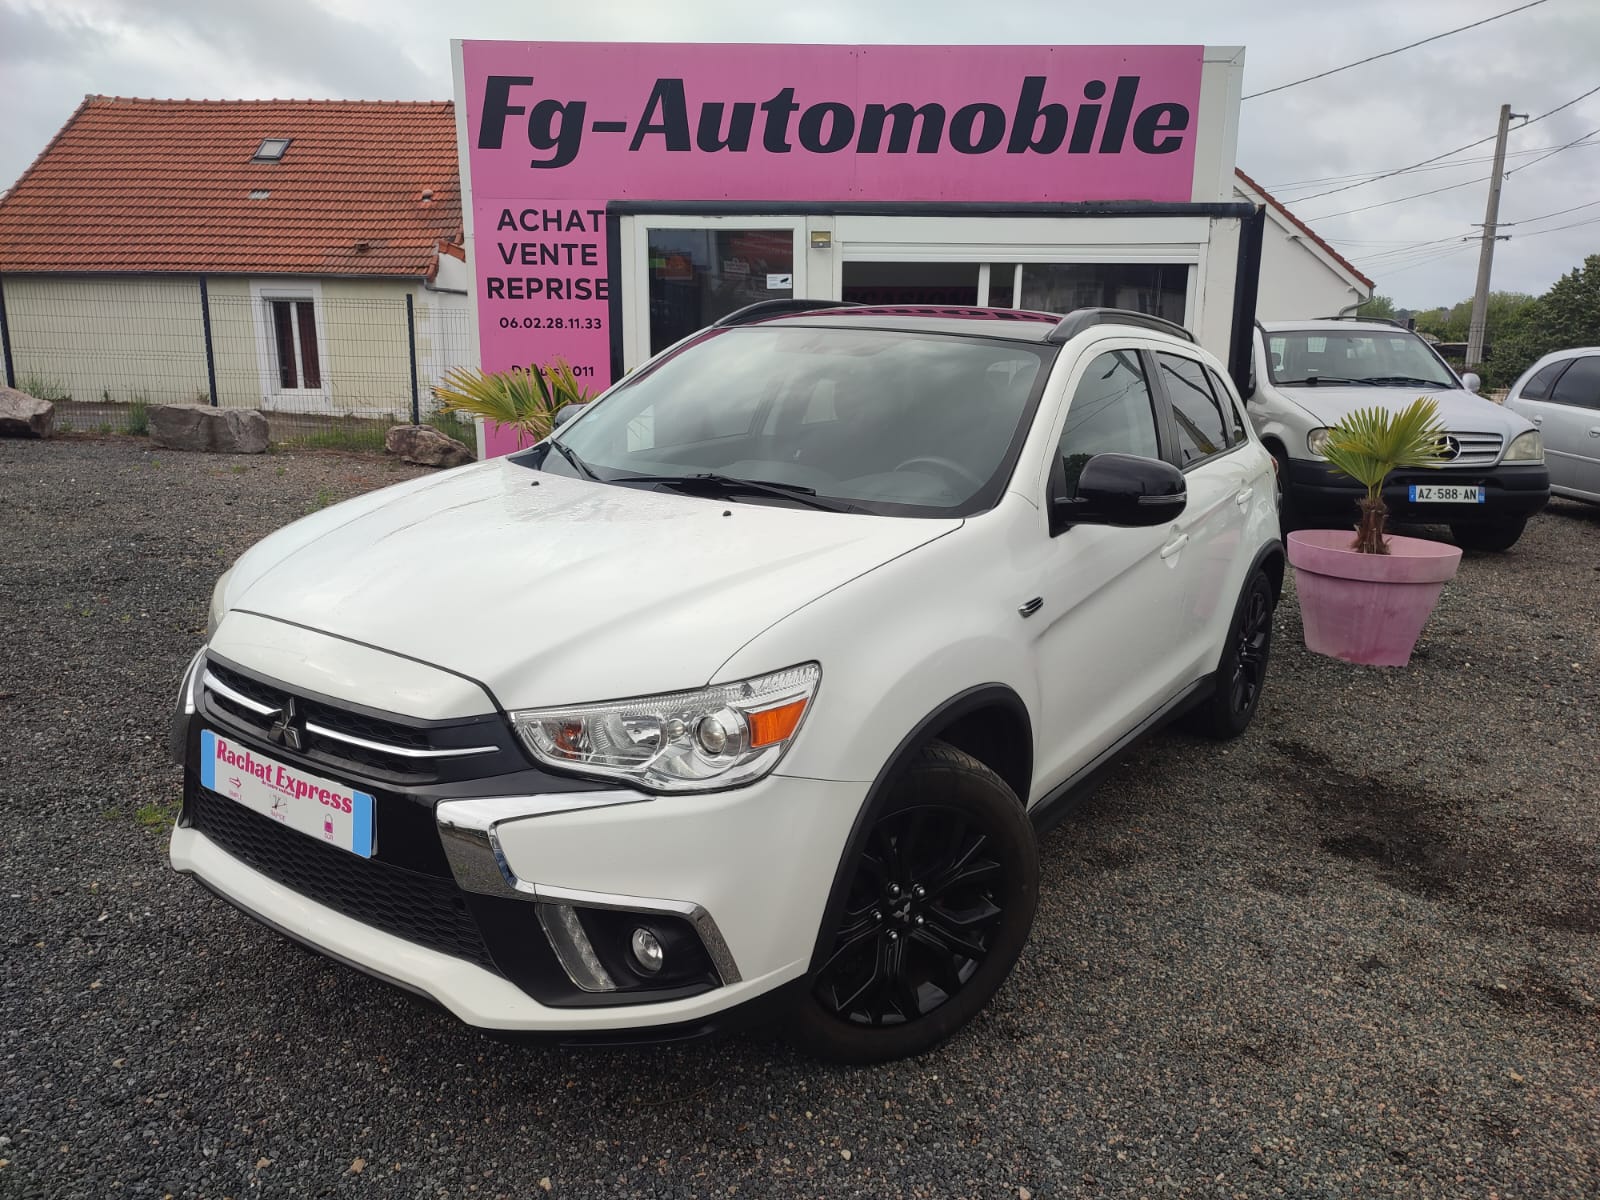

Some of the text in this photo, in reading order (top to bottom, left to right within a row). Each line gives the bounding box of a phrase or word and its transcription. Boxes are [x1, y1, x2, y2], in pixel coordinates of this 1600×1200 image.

[478, 75, 1190, 169] Fg-Automobile
[497, 209, 604, 232] ACHAT
[497, 243, 598, 266] VENTE
[487, 277, 608, 300] REPRISE
[499, 317, 602, 329] 06.02.28.11.33
[563, 366, 594, 377] 011
[1418, 488, 1477, 500] AZ-588-AN
[217, 739, 353, 814] Rachat Express
